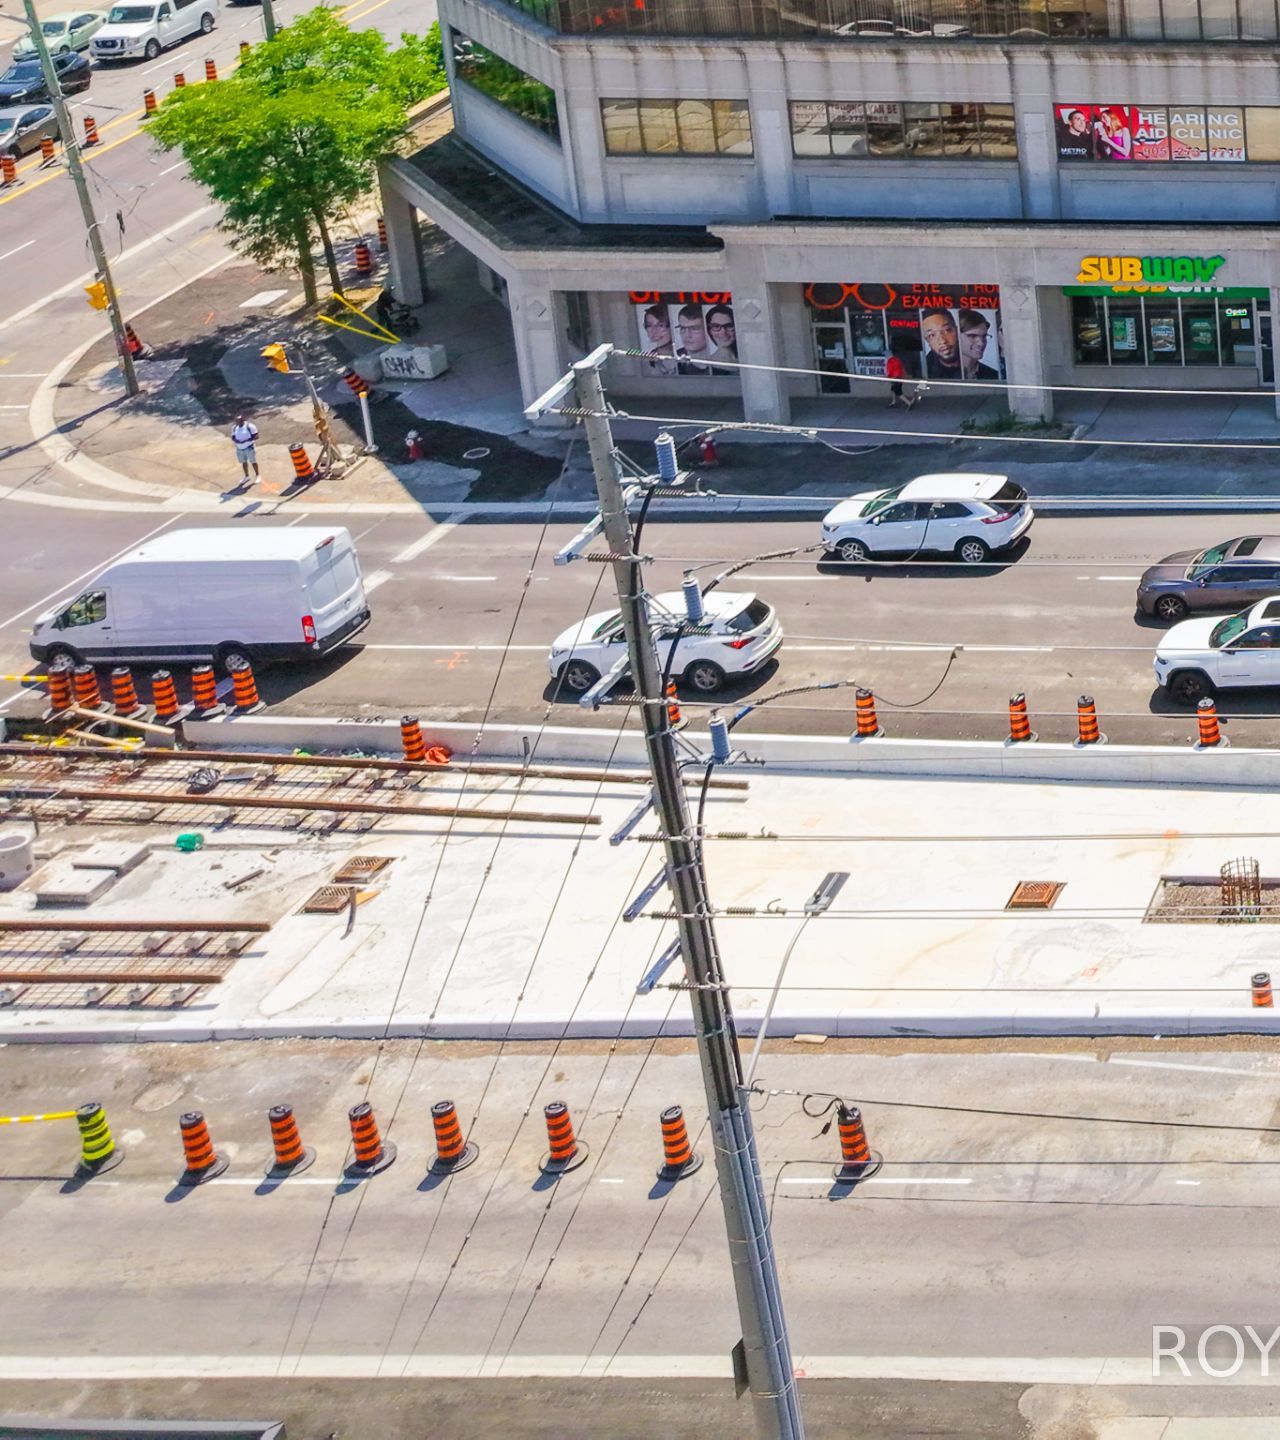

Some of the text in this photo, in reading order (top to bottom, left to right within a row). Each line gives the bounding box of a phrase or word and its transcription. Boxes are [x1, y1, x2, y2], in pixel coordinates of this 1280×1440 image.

[1138, 113, 1239, 126] HEARING
[1135, 128, 1242, 139] AID CLINIC
[1076, 255, 1225, 283] SUBWAY
[902, 295, 953, 308] EXAMS
[1225, 308, 1247, 317] Open
